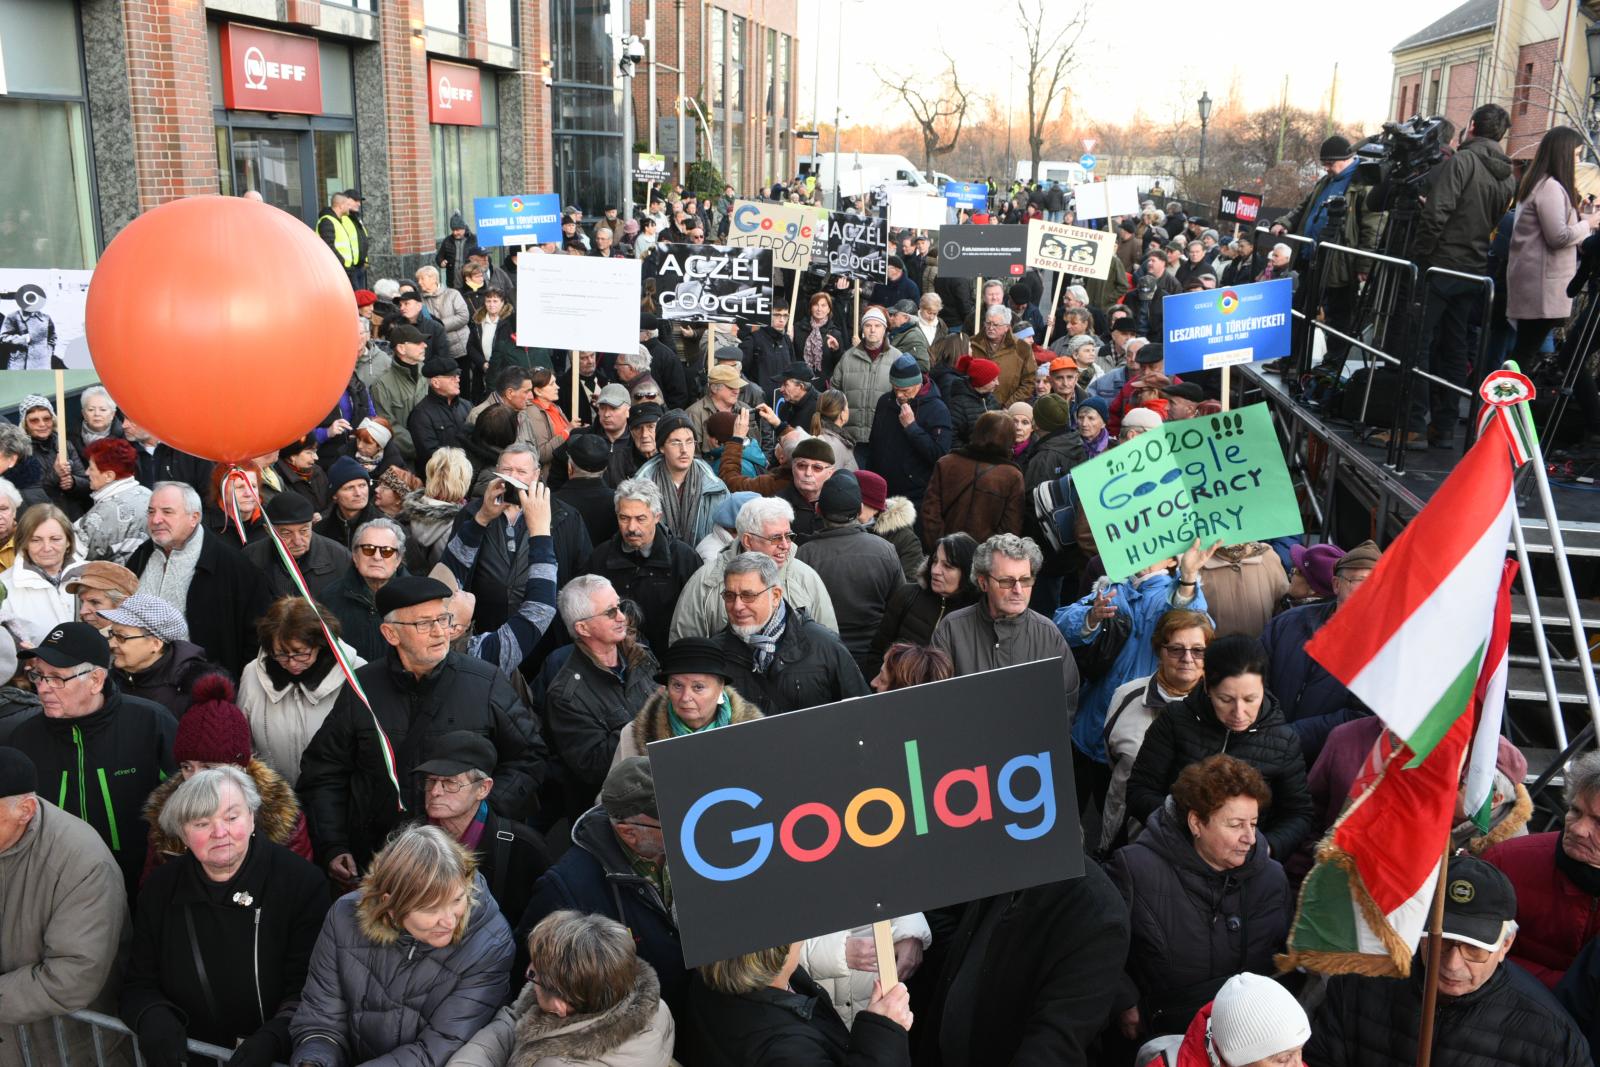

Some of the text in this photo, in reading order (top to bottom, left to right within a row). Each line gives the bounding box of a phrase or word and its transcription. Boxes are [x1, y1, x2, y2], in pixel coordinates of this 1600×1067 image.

[245, 56, 307, 83] NEFF
[734, 204, 812, 241] Google
[829, 221, 886, 247] ACZÉL
[1048, 225, 1068, 235] NAGY
[1071, 229, 1104, 241] TESTVÉR
[659, 252, 770, 282] ACZÉL
[828, 250, 886, 275] GOOGLE
[1067, 263, 1096, 275] TÉGED
[659, 291, 771, 315] GOOGLE
[1170, 313, 1285, 343] LESZAROM A TÖRVÉNYEKET!
[1099, 436, 1248, 510] Google
[1106, 459, 1125, 475] in
[1105, 467, 1262, 543] AUTOCRACY
[1182, 511, 1199, 523] in
[1125, 505, 1244, 565] HUNGARY
[680, 739, 1057, 882] Goolag
